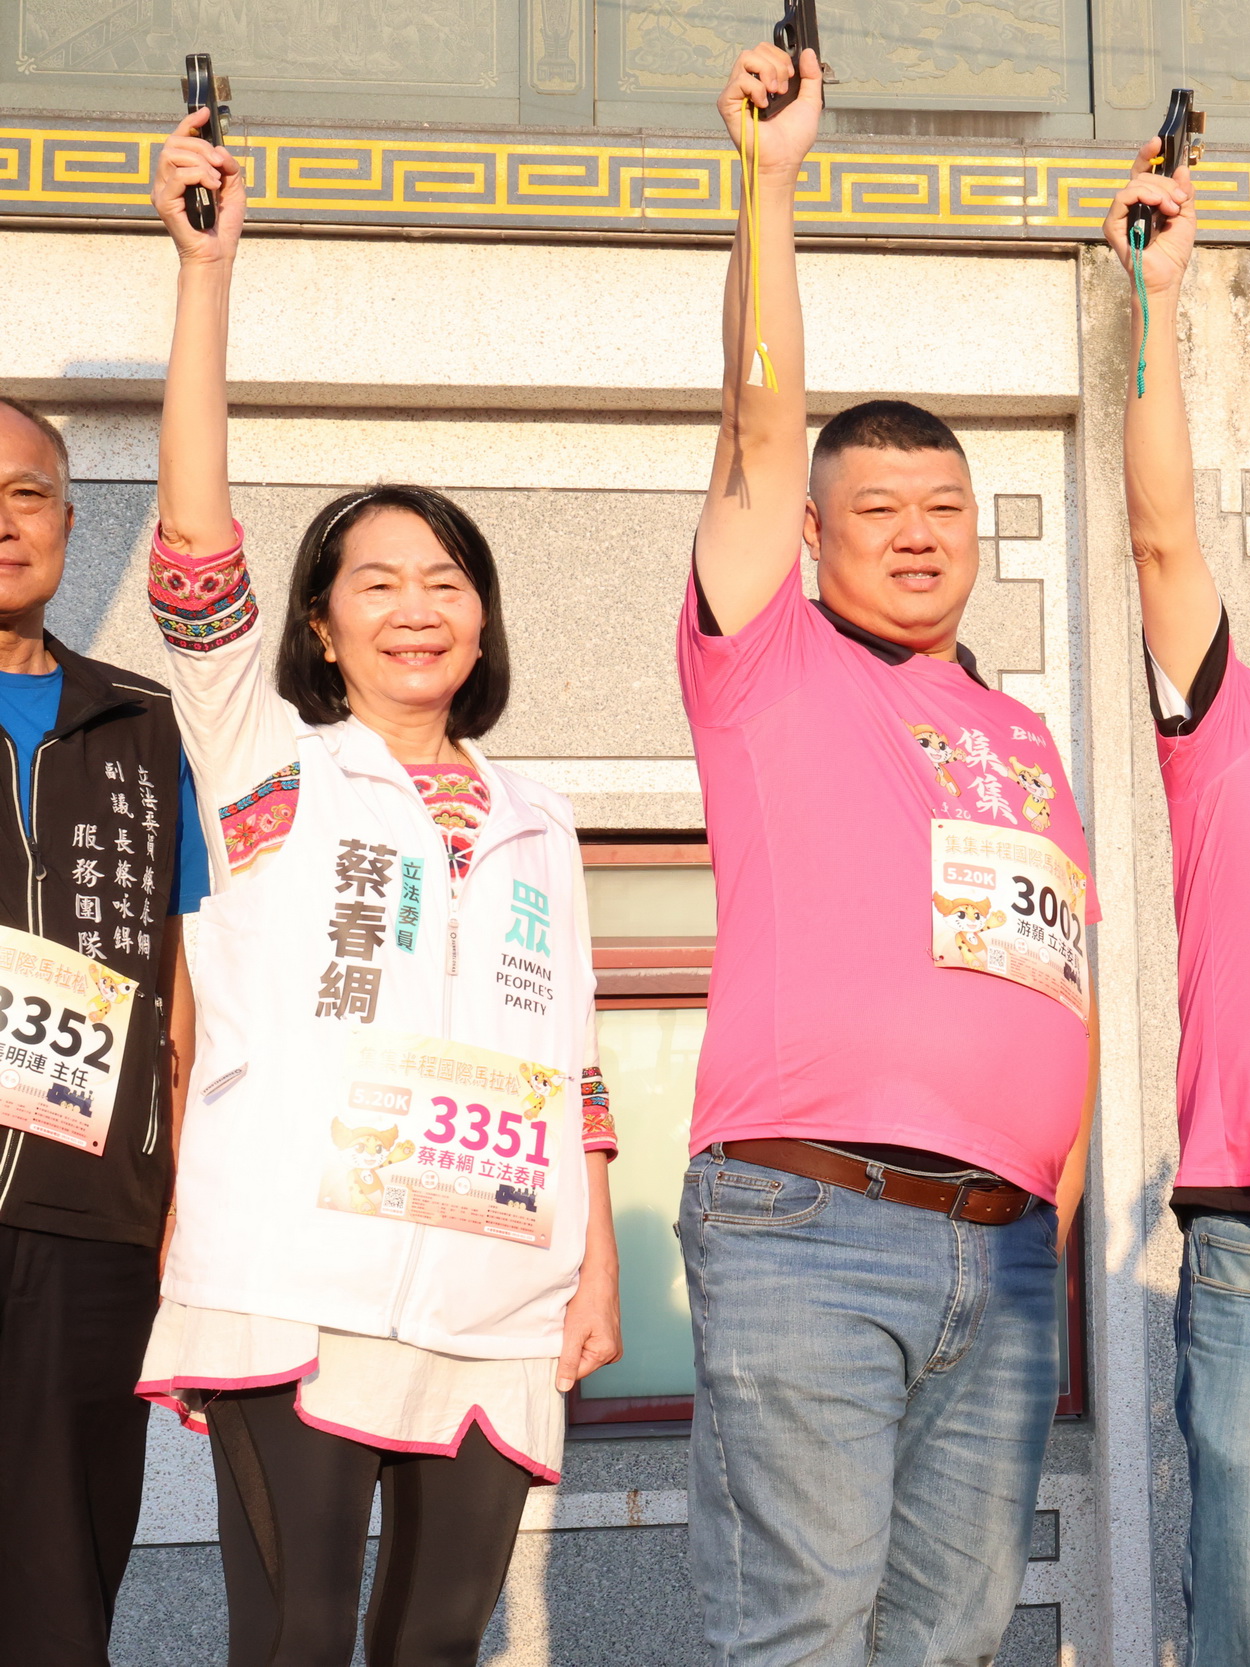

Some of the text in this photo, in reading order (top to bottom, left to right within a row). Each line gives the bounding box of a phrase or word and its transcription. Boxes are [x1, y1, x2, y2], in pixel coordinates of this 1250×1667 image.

[956, 726, 1018, 825] 集集
[72, 823, 107, 960] 服務團隊
[946, 867, 995, 887] 5.20K
[315, 838, 398, 1024] 蔡春綢
[397, 861, 421, 951] 立法委員
[505, 879, 551, 958] 眾
[1011, 875, 1083, 958] 3002
[496, 972, 554, 1001] PEOPLE'S
[501, 953, 551, 981] TAIWAN
[505, 994, 547, 1016] PARTY
[50, 1061, 89, 1089] 主任
[353, 1088, 409, 1111] 5.20K
[423, 1096, 549, 1167] 3351
[417, 1146, 545, 1190] 蔡春綢 立法委員
